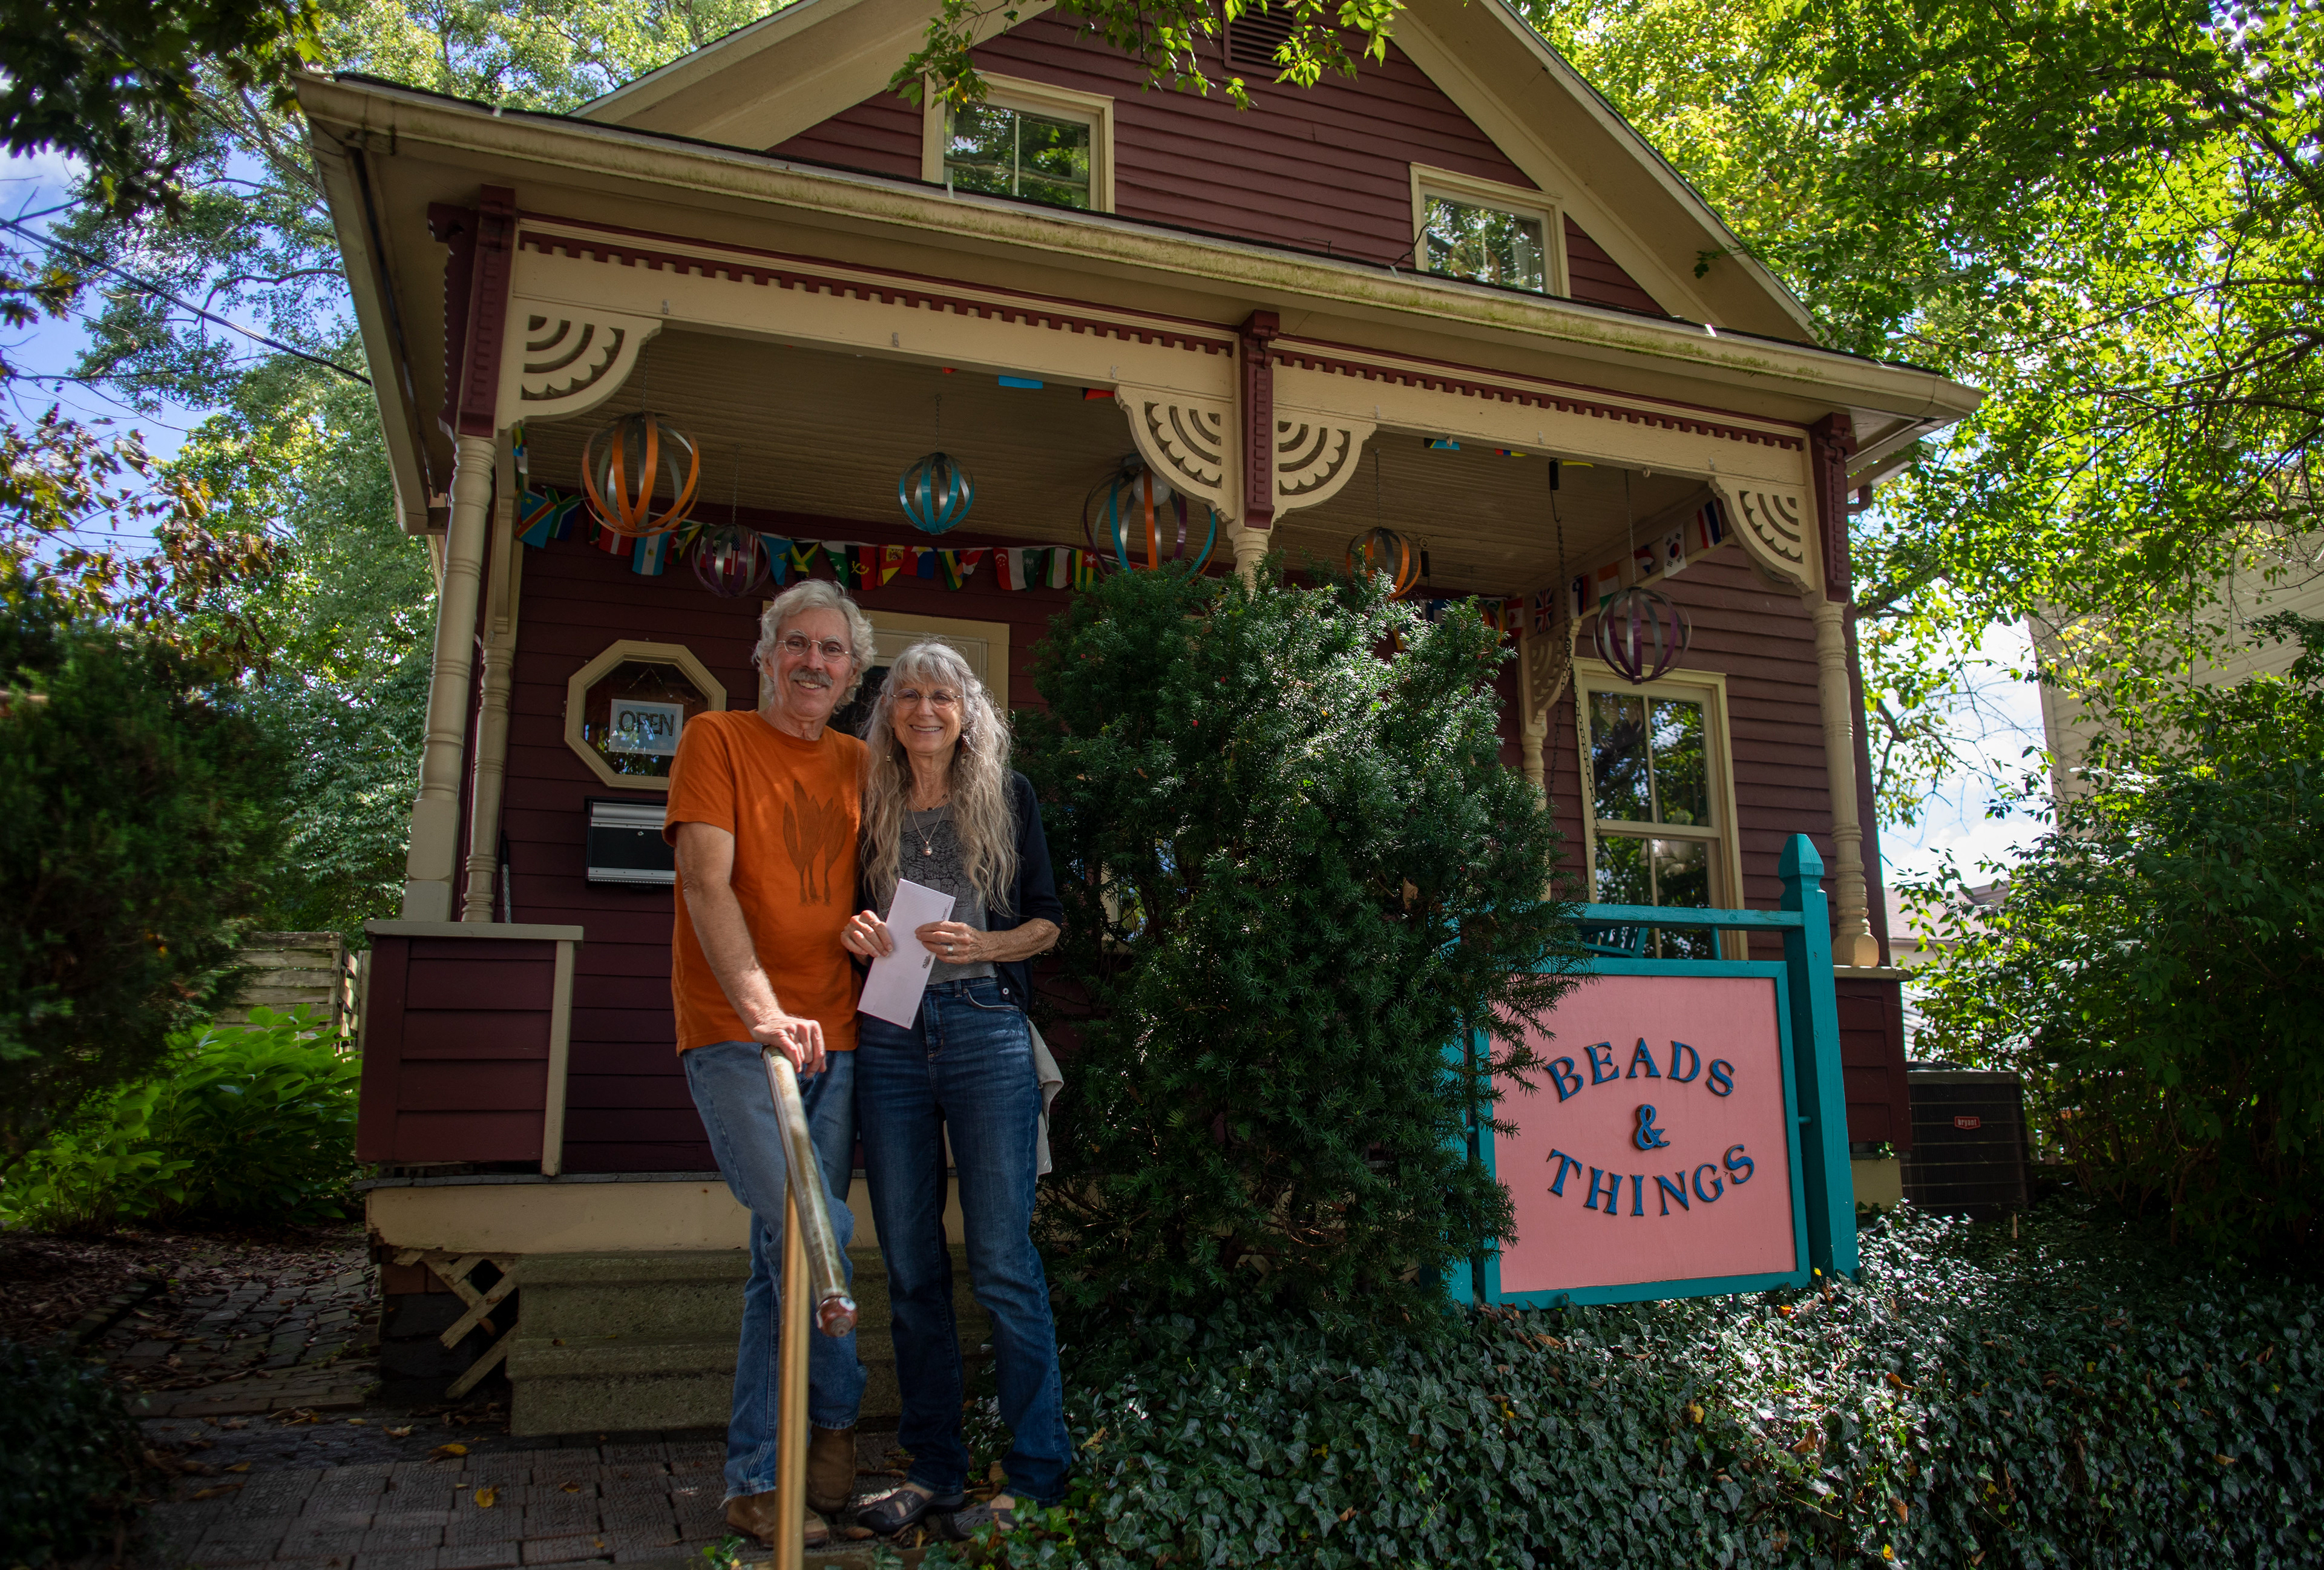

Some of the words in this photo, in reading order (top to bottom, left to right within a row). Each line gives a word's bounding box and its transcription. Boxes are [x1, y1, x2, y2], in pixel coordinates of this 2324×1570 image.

[619, 711, 674, 736] OPEN
[1544, 1037, 1736, 1102] BEADS
[1633, 1104, 1670, 1151] &
[1957, 1118, 1977, 1127] bryant
[1546, 1144, 1754, 1216] THINGS
